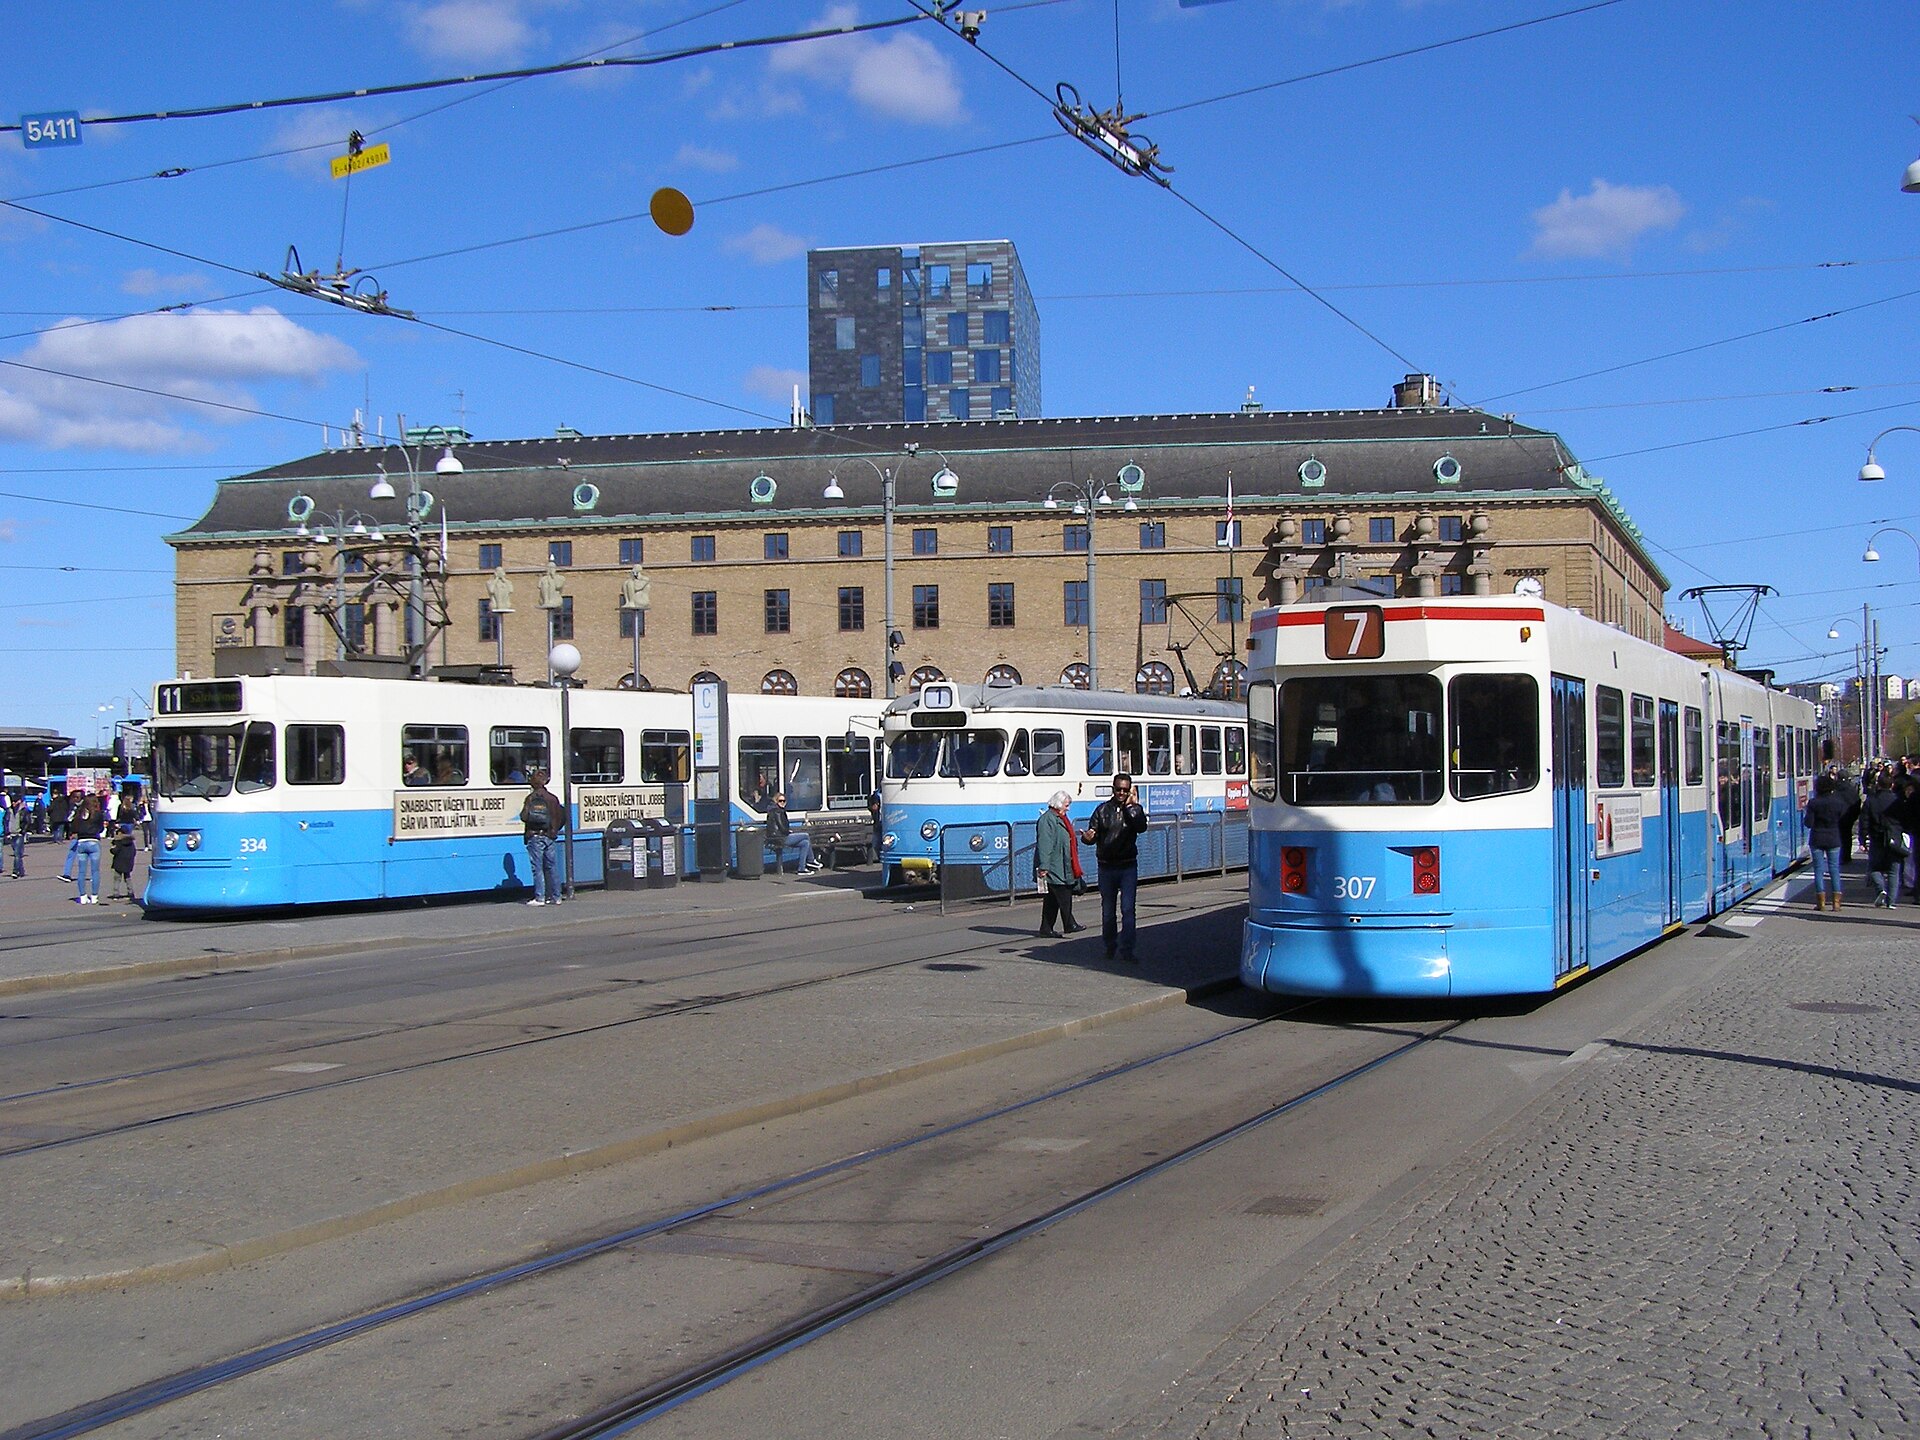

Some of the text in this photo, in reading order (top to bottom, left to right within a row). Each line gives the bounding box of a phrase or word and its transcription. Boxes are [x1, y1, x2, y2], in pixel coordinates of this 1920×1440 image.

[27, 117, 77, 142] 5411
[1344, 612, 1368, 655] 7
[163, 687, 181, 712] 11
[703, 687, 711, 709] C
[935, 688, 942, 704] 1
[496, 731, 504, 744] 11
[400, 796, 505, 813] SNABBASTE VÄGEN TILL JOBBET
[583, 794, 617, 807] SNABBASTE
[618, 792, 635, 806] VÄGEN
[636, 794, 647, 806] TILL
[400, 815, 416, 830] GÅR
[416, 816, 429, 829] VIA
[583, 808, 596, 822] GÅR
[597, 810, 606, 822] VIA
[239, 838, 267, 853] 334
[1333, 876, 1377, 899] 307
